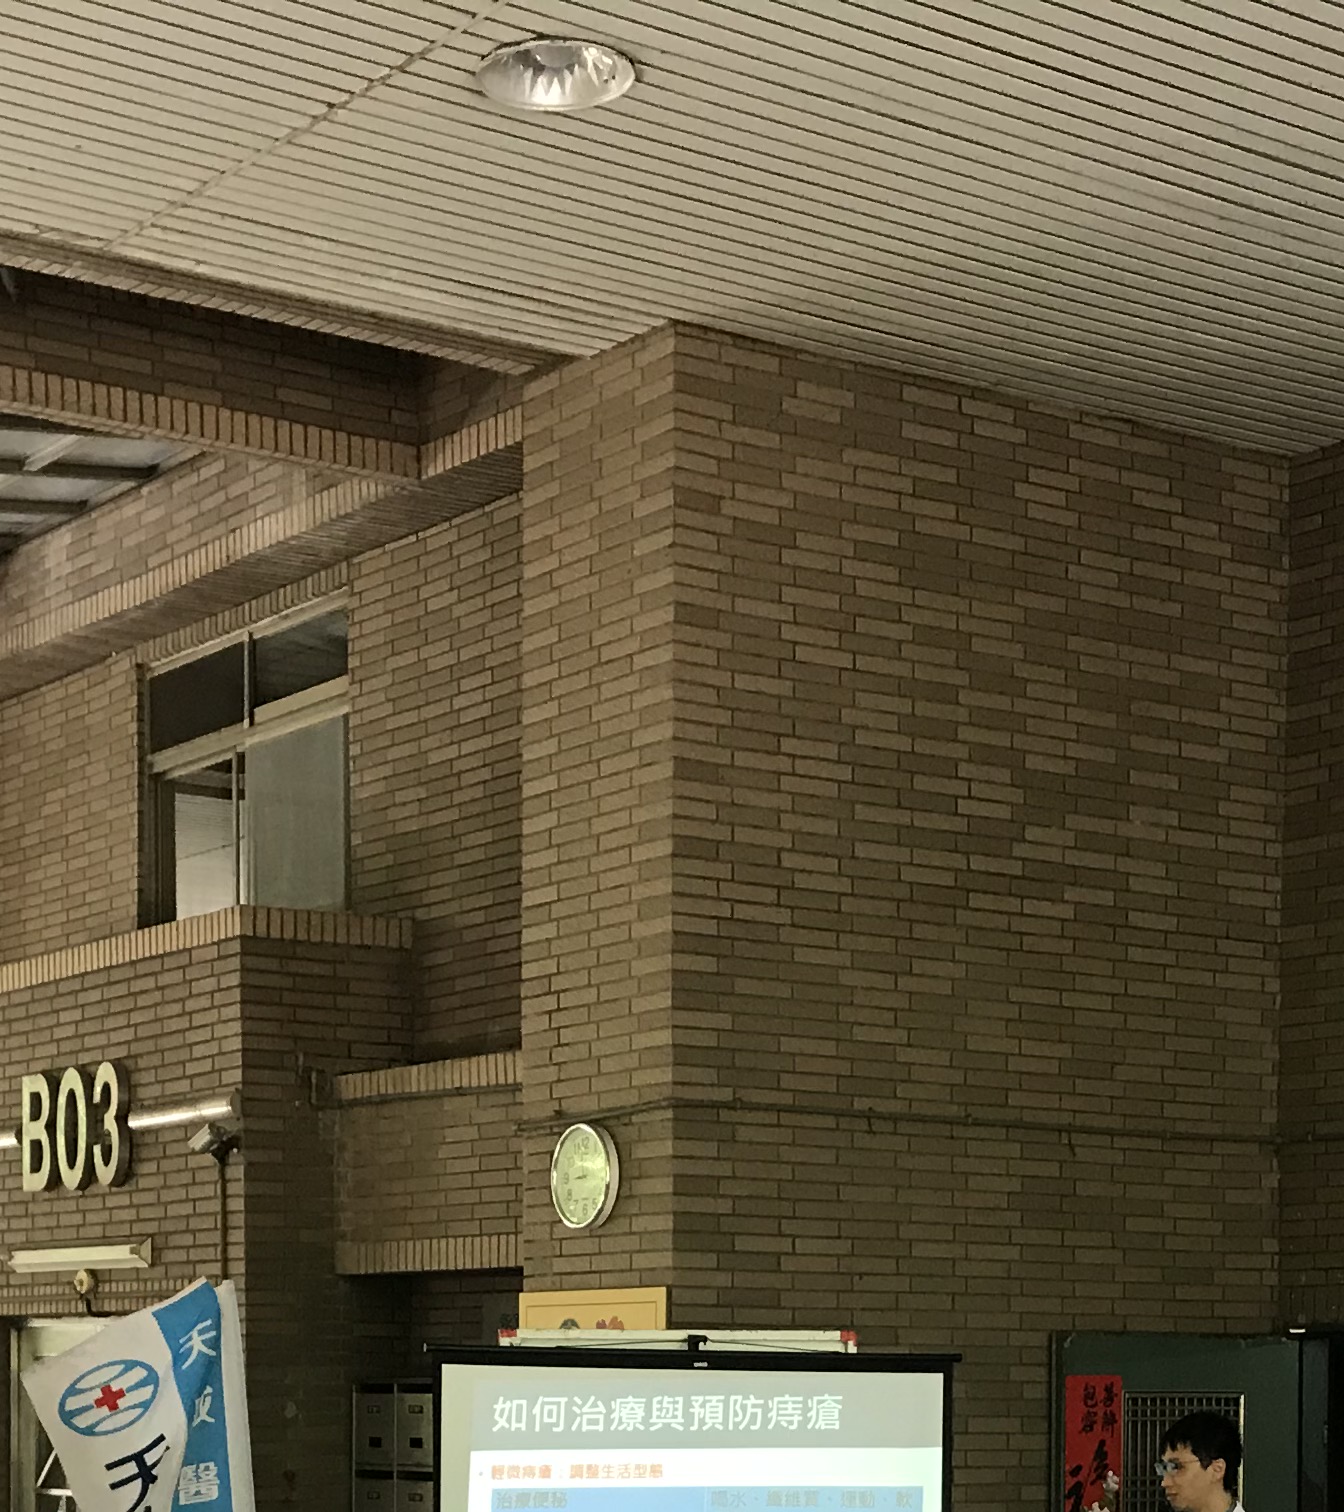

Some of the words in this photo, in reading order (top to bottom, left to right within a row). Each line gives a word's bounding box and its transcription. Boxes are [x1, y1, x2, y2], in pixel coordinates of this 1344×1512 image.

[492, 1393, 843, 1432] 如何治療與預防痔瘡
